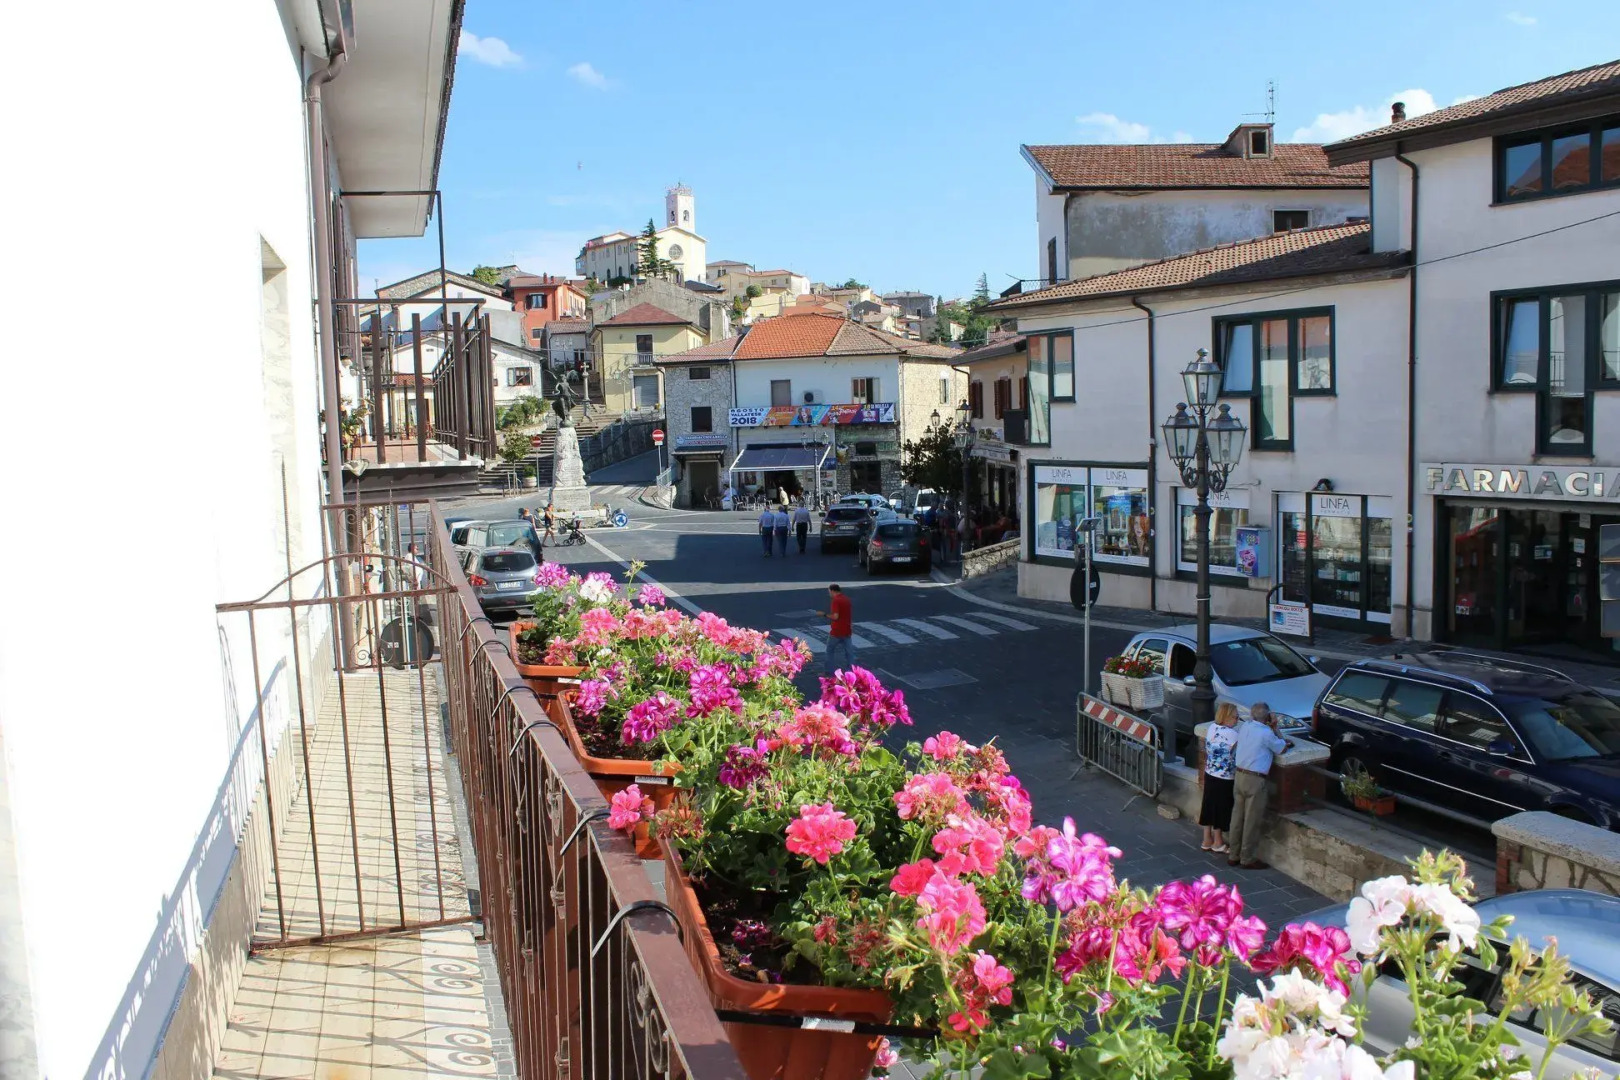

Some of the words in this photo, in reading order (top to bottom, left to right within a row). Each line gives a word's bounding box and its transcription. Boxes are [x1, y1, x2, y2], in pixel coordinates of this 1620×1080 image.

[731, 417, 757, 425] 2018
[1051, 469, 1072, 478] LINFA
[1105, 470, 1128, 480] LINFA
[1320, 497, 1350, 510] LINFA
